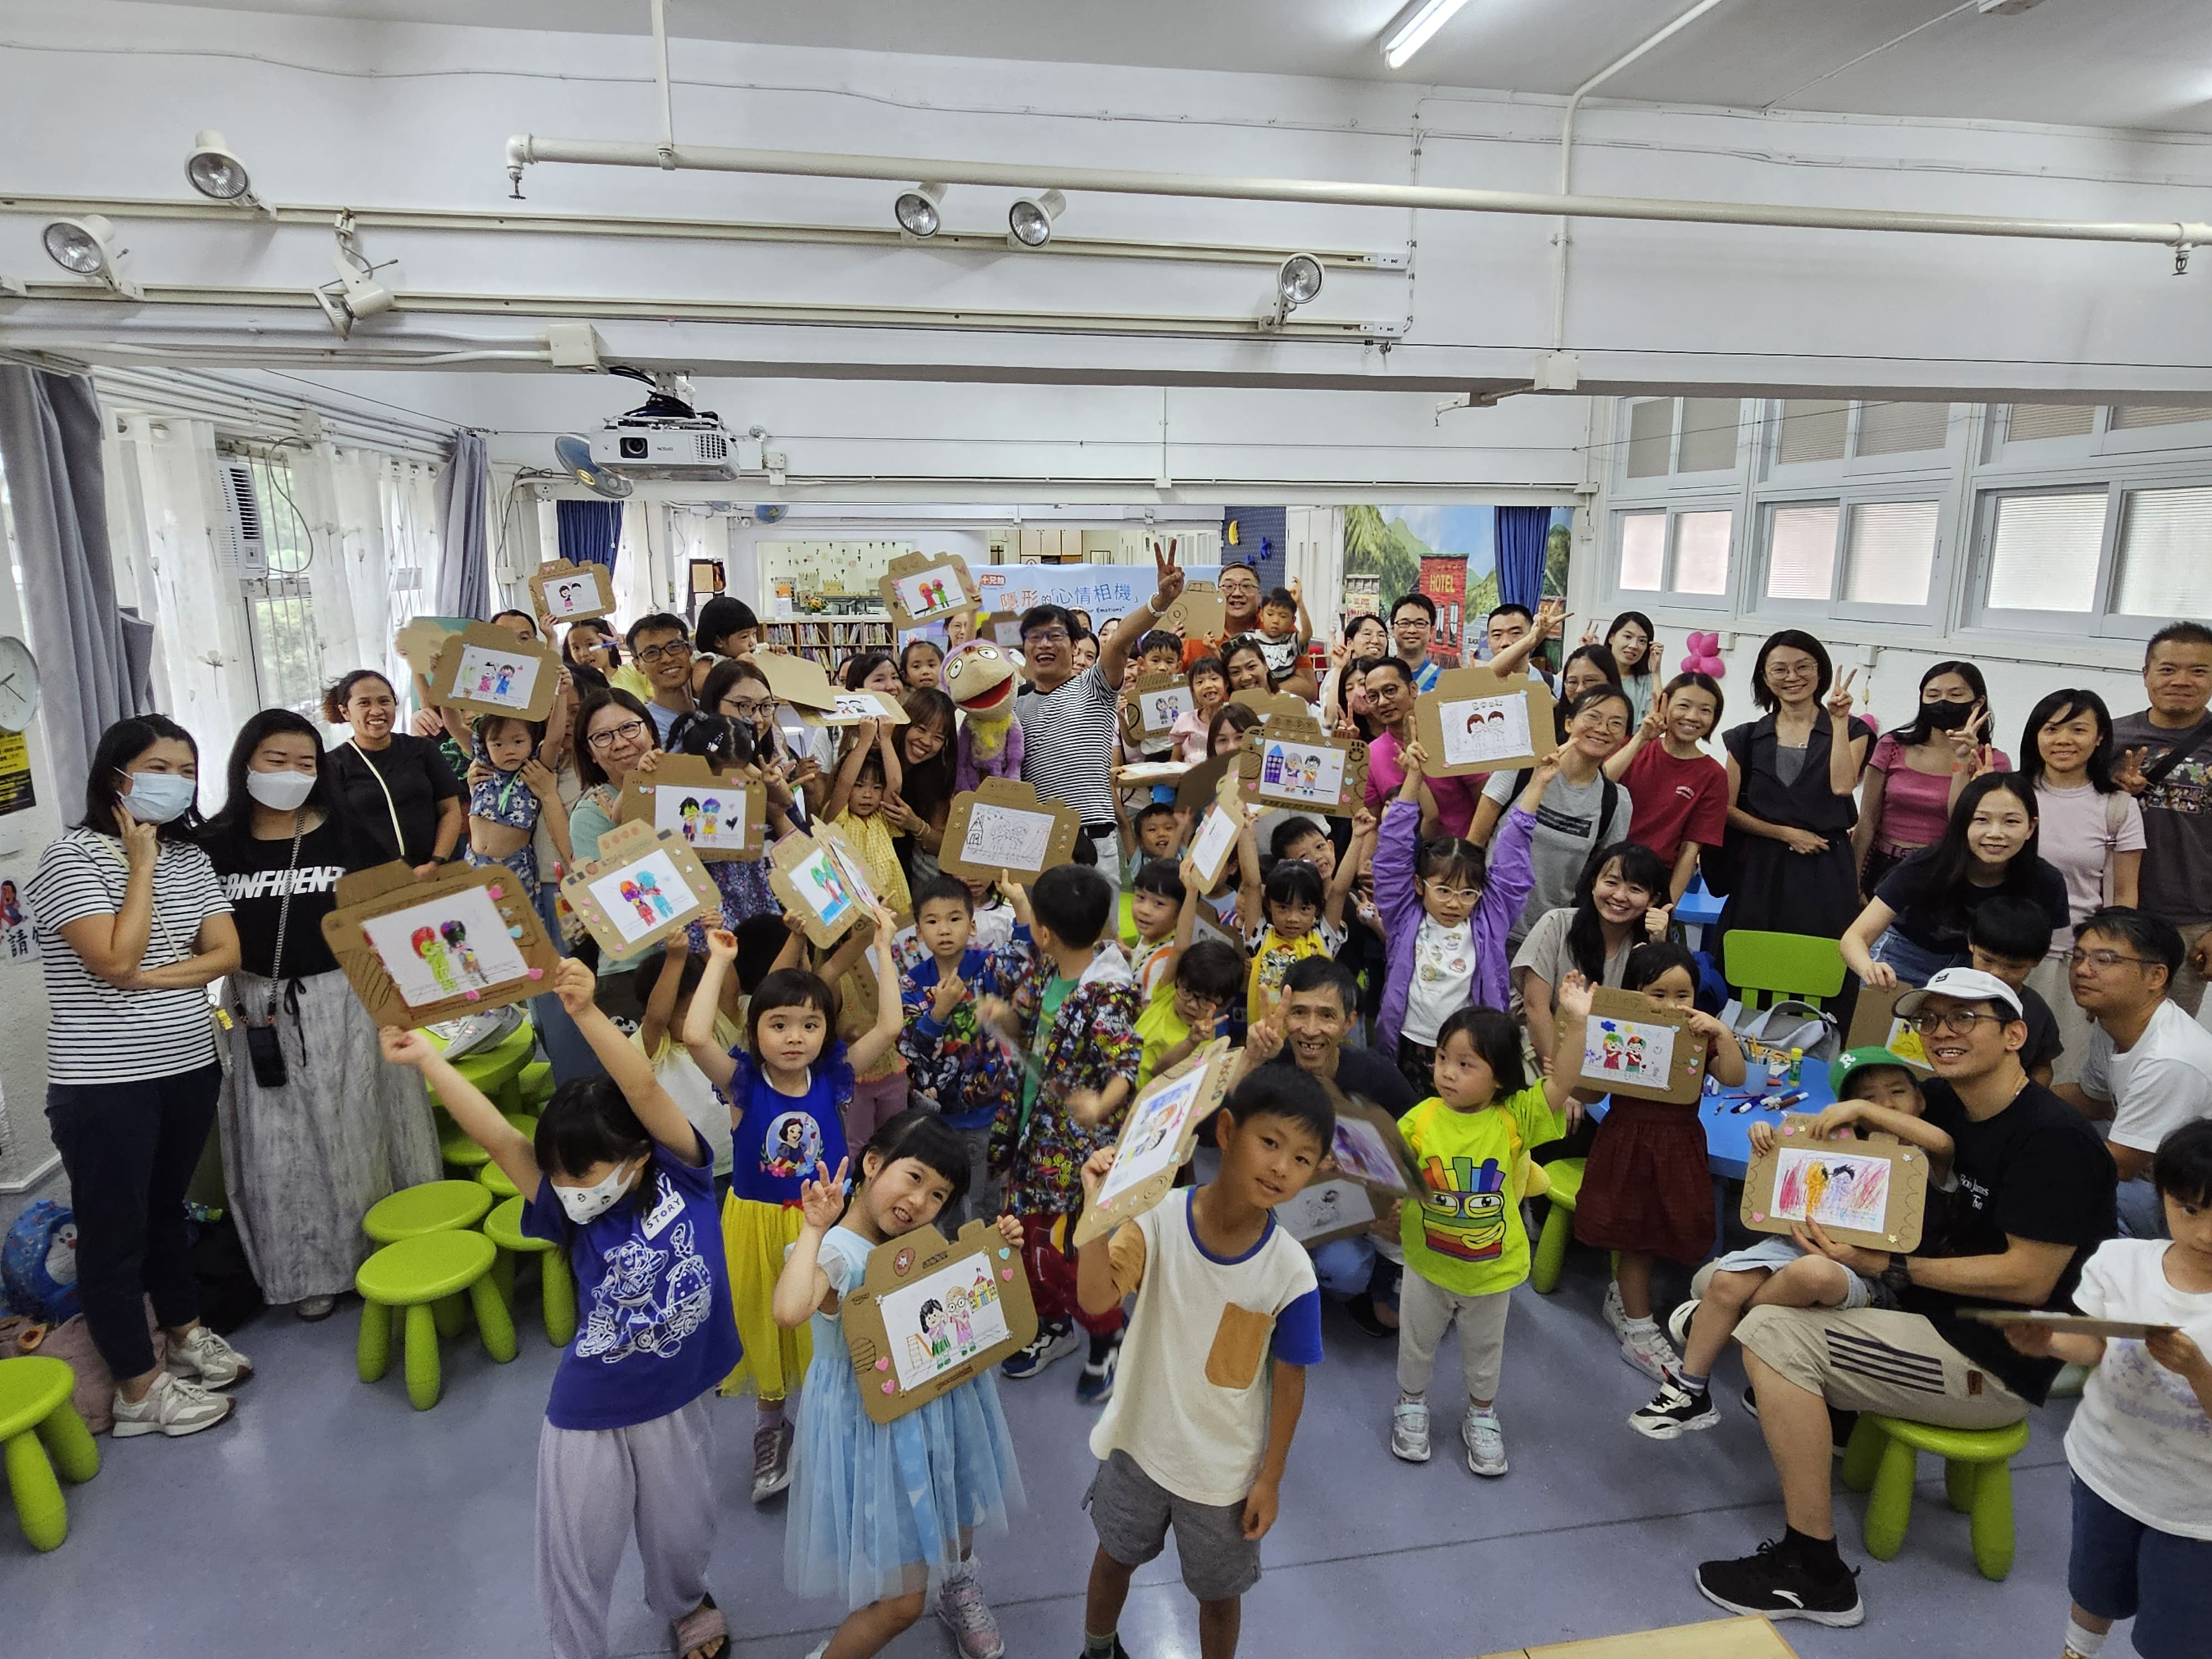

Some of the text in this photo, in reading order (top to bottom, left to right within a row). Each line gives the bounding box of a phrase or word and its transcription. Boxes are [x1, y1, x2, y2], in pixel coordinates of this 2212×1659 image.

[1430, 574, 1456, 593] HOTEL
[1839, 1053, 1856, 1068] R
[646, 1197, 680, 1229] STORY
